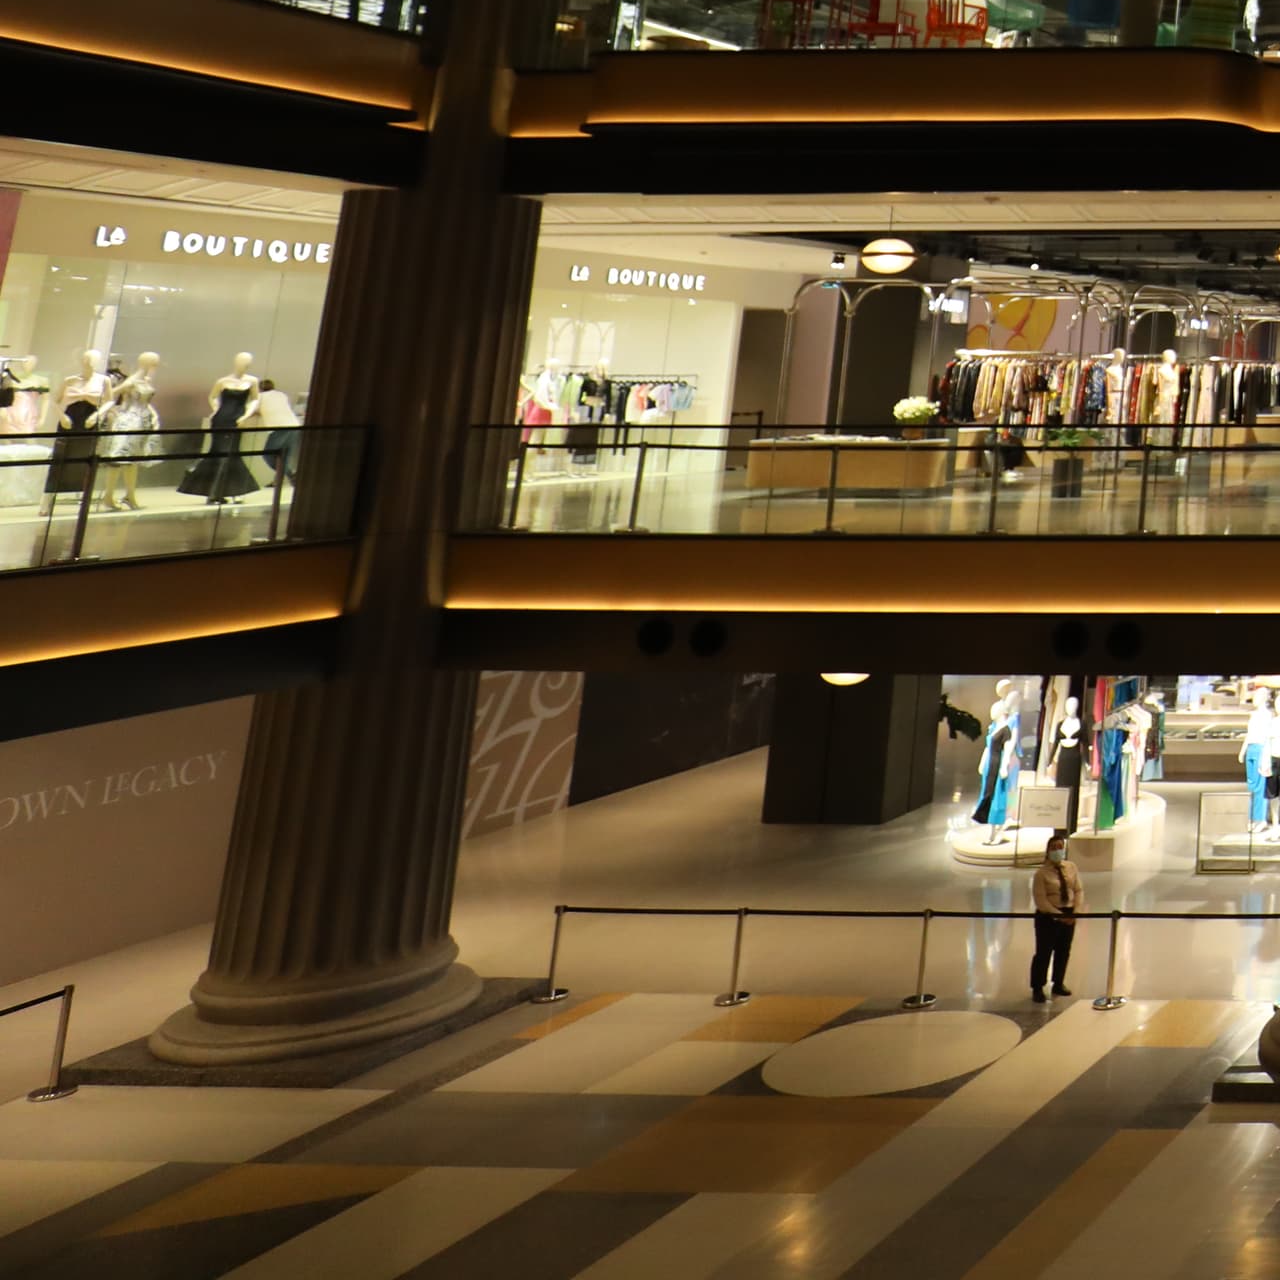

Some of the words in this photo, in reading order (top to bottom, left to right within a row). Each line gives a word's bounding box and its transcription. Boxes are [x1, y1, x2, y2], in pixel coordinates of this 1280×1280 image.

[162, 230, 332, 264] BOUTIQUE
[607, 267, 706, 291] BOUTIQUE
[101, 749, 230, 806] LEGACY
